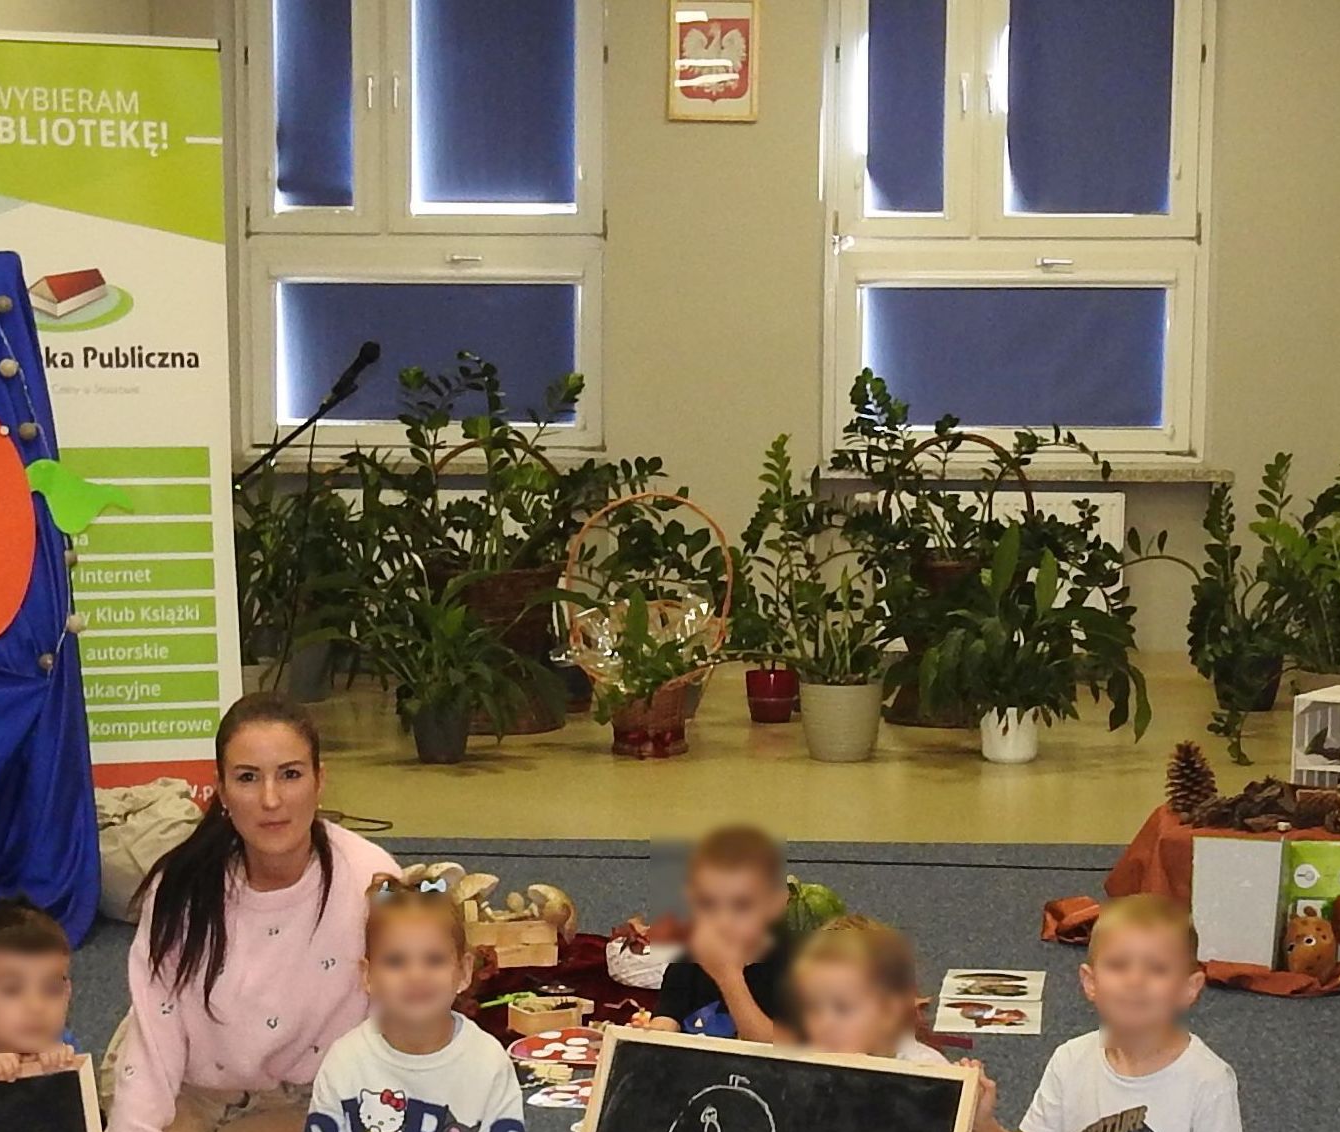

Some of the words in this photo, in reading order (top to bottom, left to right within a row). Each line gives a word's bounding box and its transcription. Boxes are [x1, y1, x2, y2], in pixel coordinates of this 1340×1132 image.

[44, 345, 75, 369] ka
[82, 344, 201, 369] Publiczna
[95, 606, 136, 624] Klub
[140, 603, 201, 626] Książki
[85, 642, 170, 662] autorskie
[82, 680, 162, 702] ukacyjne
[88, 717, 213, 739] komputerowe
